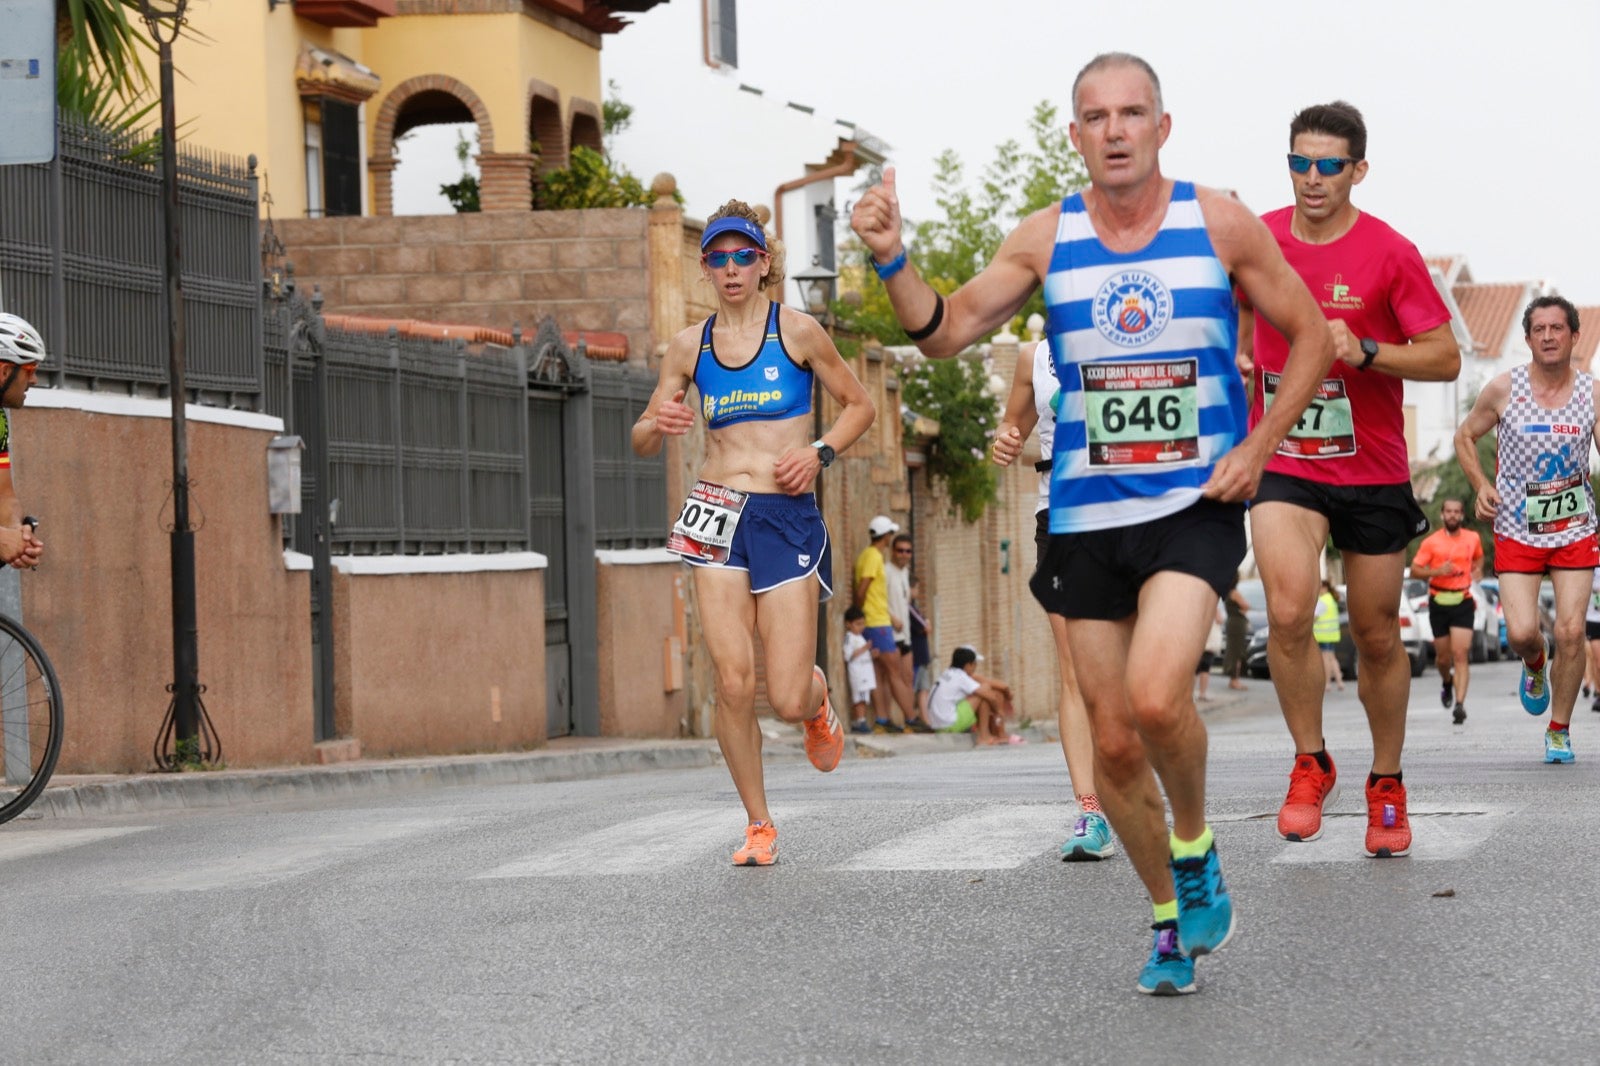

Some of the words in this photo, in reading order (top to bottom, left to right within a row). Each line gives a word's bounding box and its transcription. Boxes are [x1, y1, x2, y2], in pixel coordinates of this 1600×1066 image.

[1121, 274, 1167, 318] RUNNERS
[1108, 326, 1160, 344] ESPANYOL
[1106, 366, 1126, 379] GRAN
[1127, 365, 1156, 379] PREMIO
[1156, 364, 1167, 377] DE
[1167, 363, 1191, 377] FONDO
[719, 390, 782, 406] olimpo
[1102, 395, 1182, 433] 646
[1552, 424, 1581, 436] SEUR
[1538, 492, 1578, 518] 773
